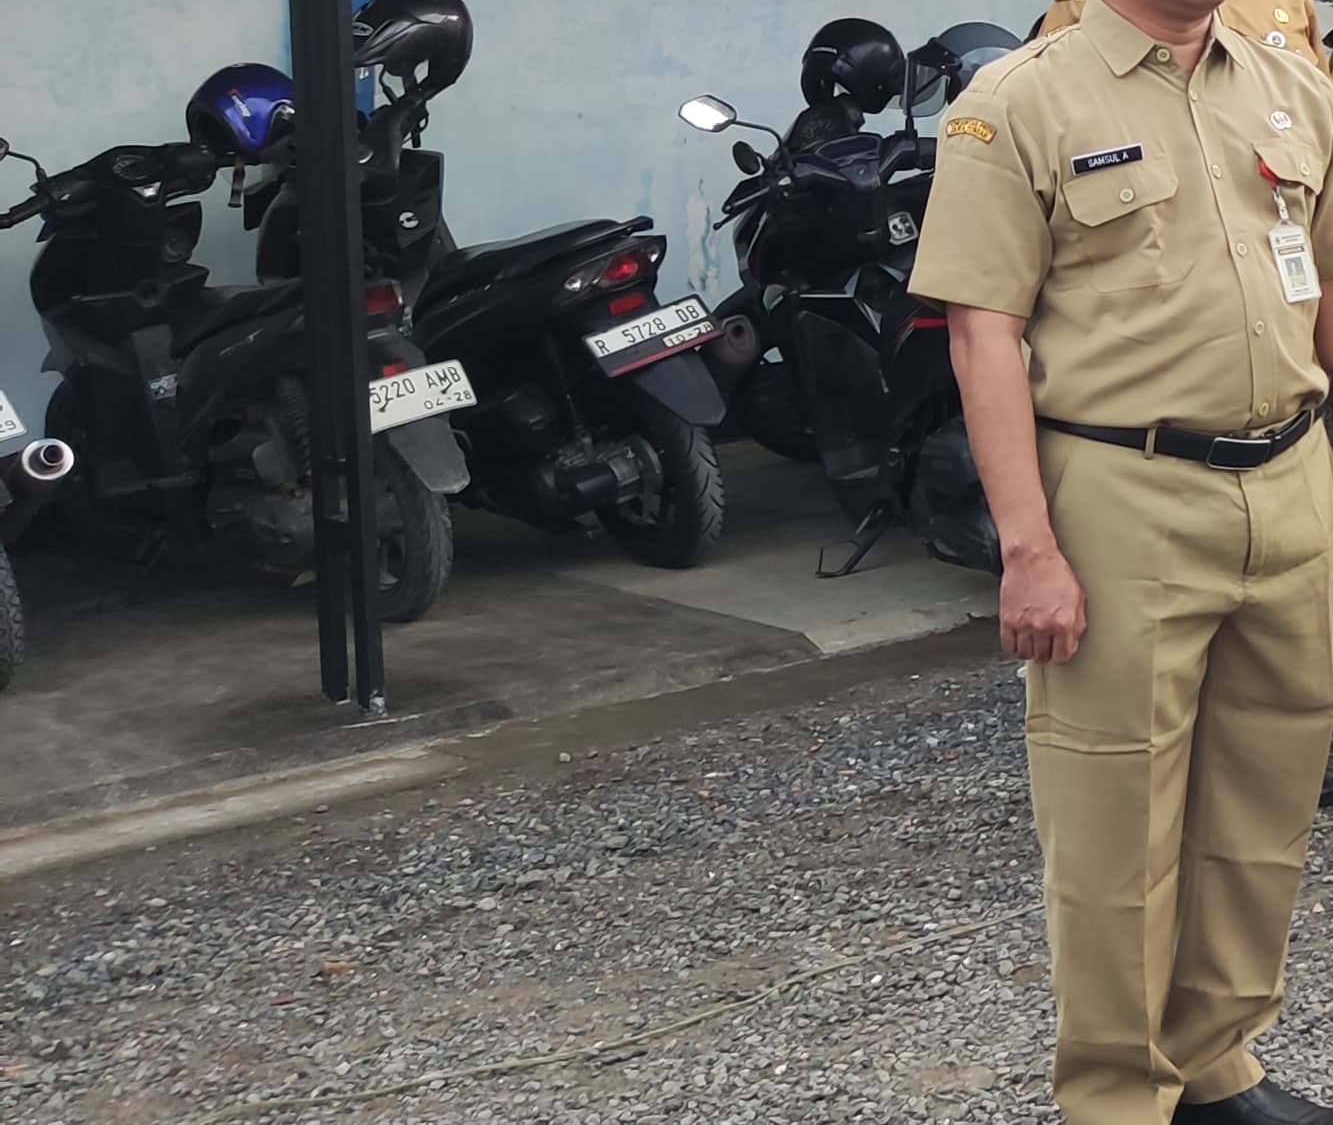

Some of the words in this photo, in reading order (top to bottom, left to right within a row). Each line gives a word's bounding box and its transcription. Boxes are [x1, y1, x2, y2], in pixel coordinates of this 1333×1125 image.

[1087, 153, 1121, 168] SAMSUL
[1122, 151, 1129, 160] A
[594, 339, 610, 355] R
[621, 317, 667, 344] 5728
[675, 305, 700, 323] DB
[368, 377, 416, 404] 5220
[424, 366, 462, 389] AMB
